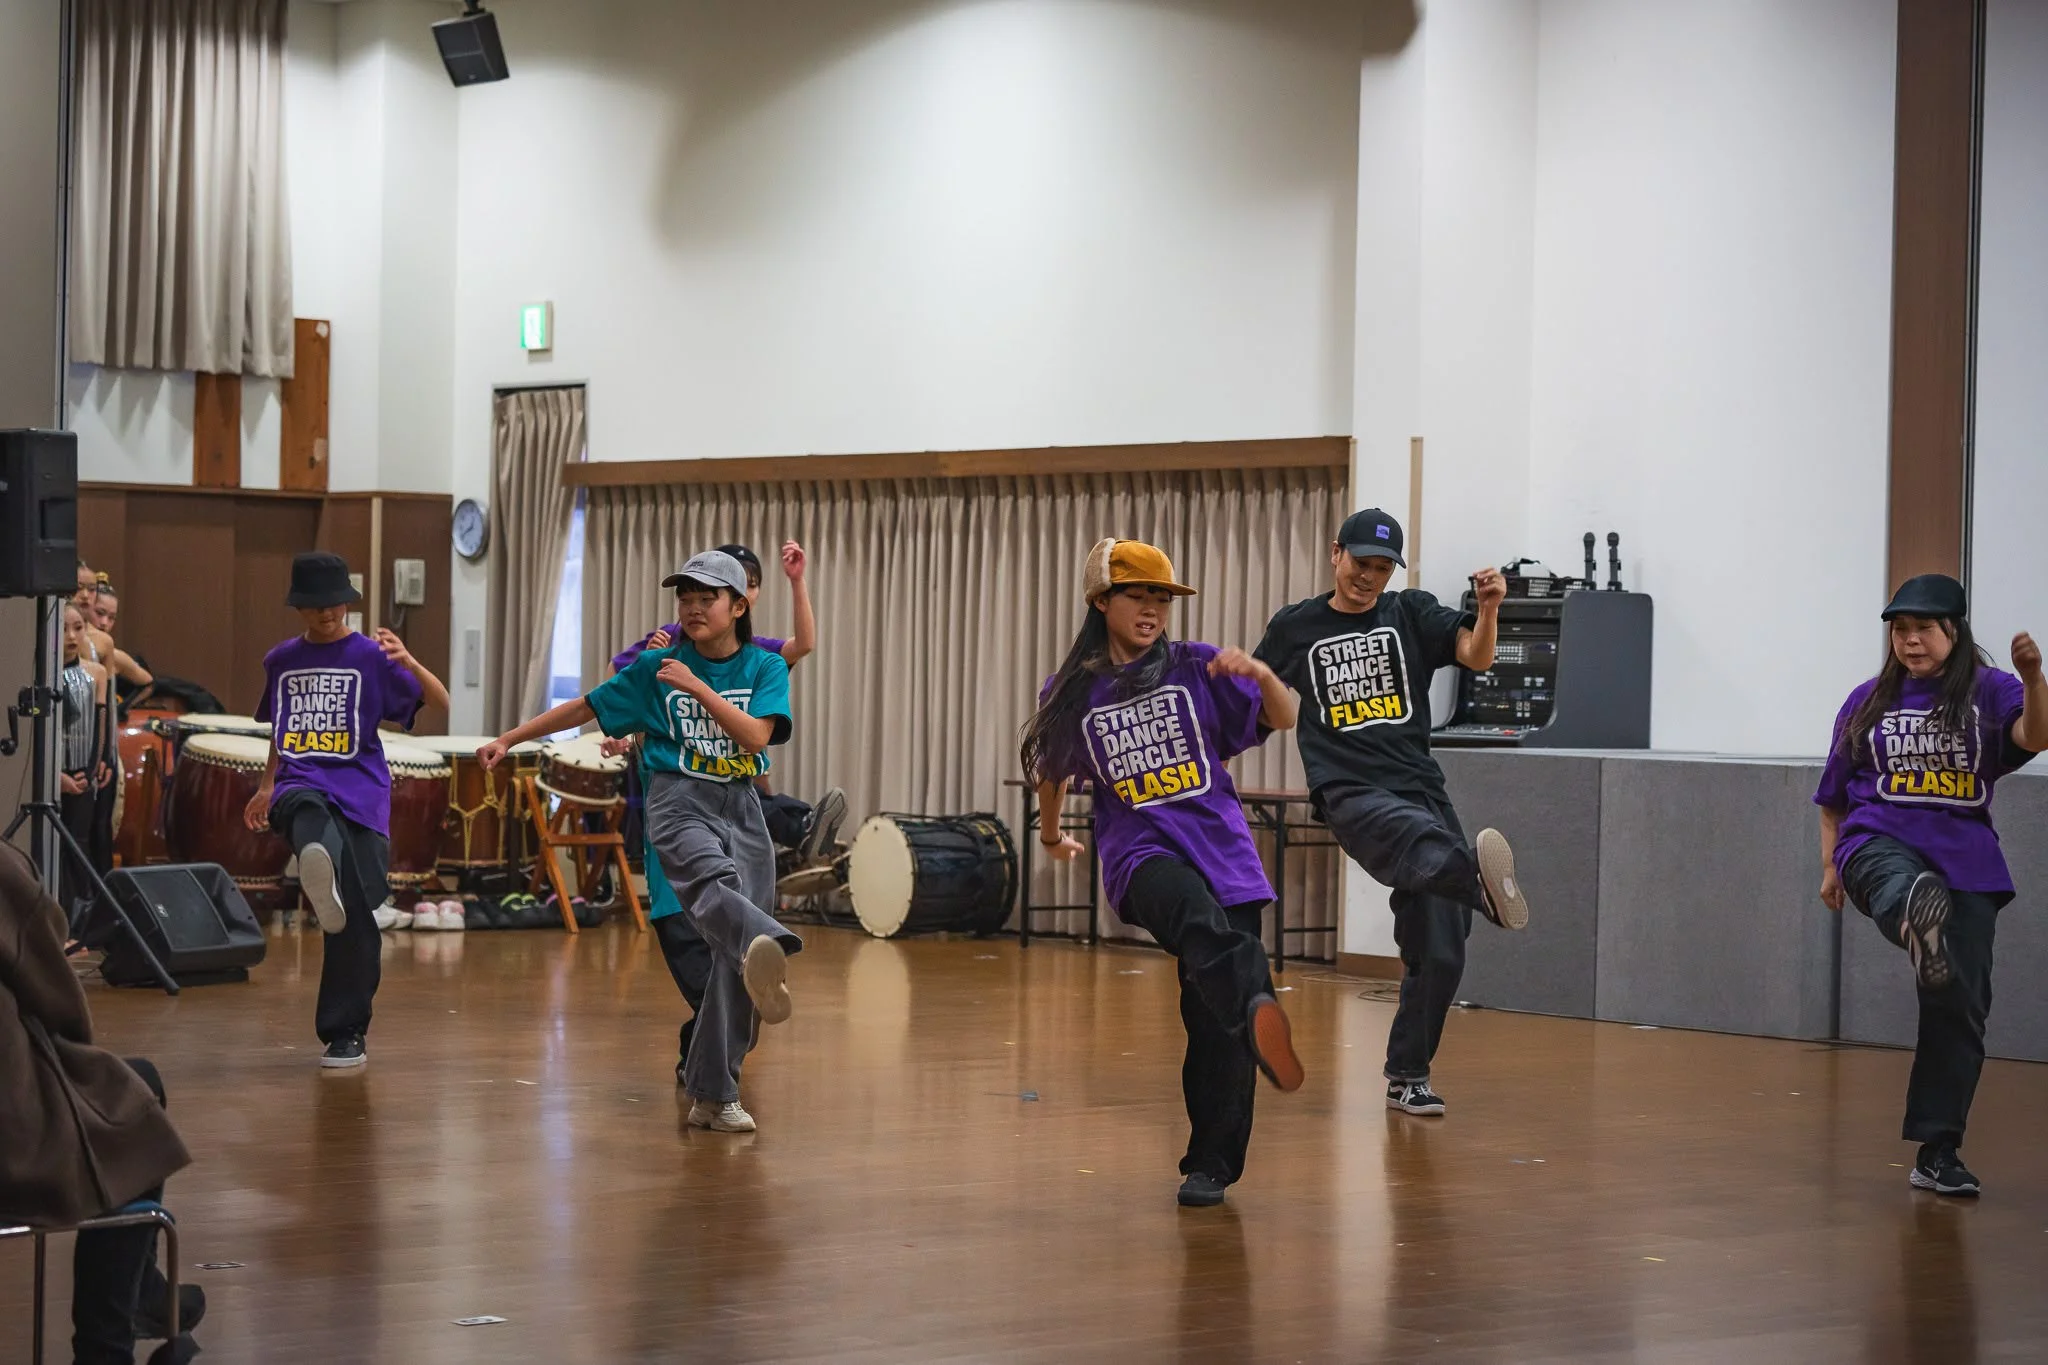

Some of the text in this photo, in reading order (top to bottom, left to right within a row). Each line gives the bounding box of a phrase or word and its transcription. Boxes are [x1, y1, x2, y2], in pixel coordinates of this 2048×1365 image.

[1319, 633, 1390, 667] STREET
[1326, 654, 1392, 686] DANCE
[287, 675, 353, 695] STREET
[1327, 675, 1396, 705] CIRCLE
[290, 693, 347, 714] DANCE
[676, 696, 752, 718] STET
[1093, 693, 1178, 737] STREET
[1330, 695, 1402, 728] FLASH
[287, 712, 348, 732] CRCLE
[1881, 716, 1967, 735] STRE
[283, 731, 349, 753] FLASH
[1101, 715, 1184, 759] DANCE
[1885, 731, 1967, 757] DANCE
[692, 752, 757, 778] FLASH
[1107, 738, 1191, 781] CIRCLE
[1887, 753, 1971, 773] CIRCLE
[1113, 761, 1200, 804] FLASH
[1890, 770, 1975, 798] FLASH
